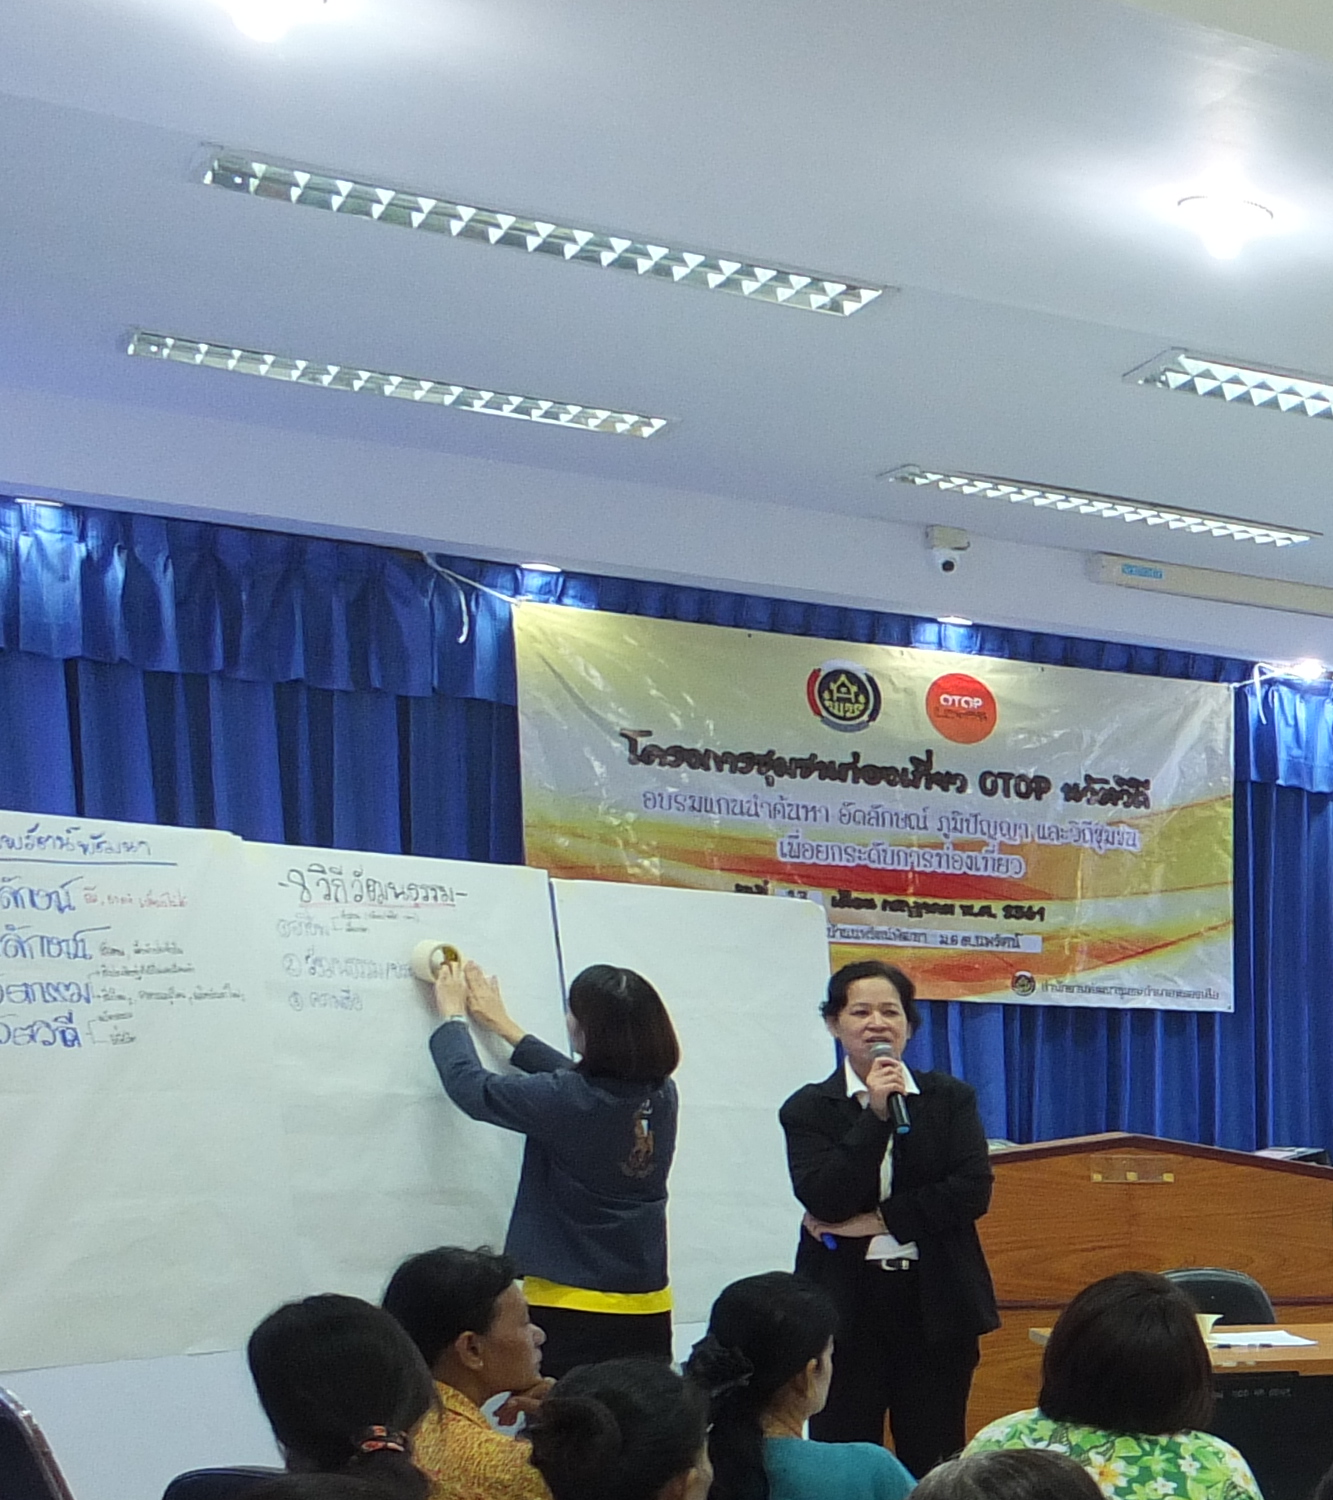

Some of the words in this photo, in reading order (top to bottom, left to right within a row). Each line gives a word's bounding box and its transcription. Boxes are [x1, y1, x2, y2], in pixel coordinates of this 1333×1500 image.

[939, 694, 983, 710] OTOP
[978, 770, 1052, 800] OTOP
[643, 791, 830, 823] อบรมแกนนำค้นหา
[937, 812, 1030, 839] ภูมิปัญญา
[779, 835, 1024, 875] เพื่อยกระดับการท่องเที่ยว
[1003, 903, 1046, 922] 2561
